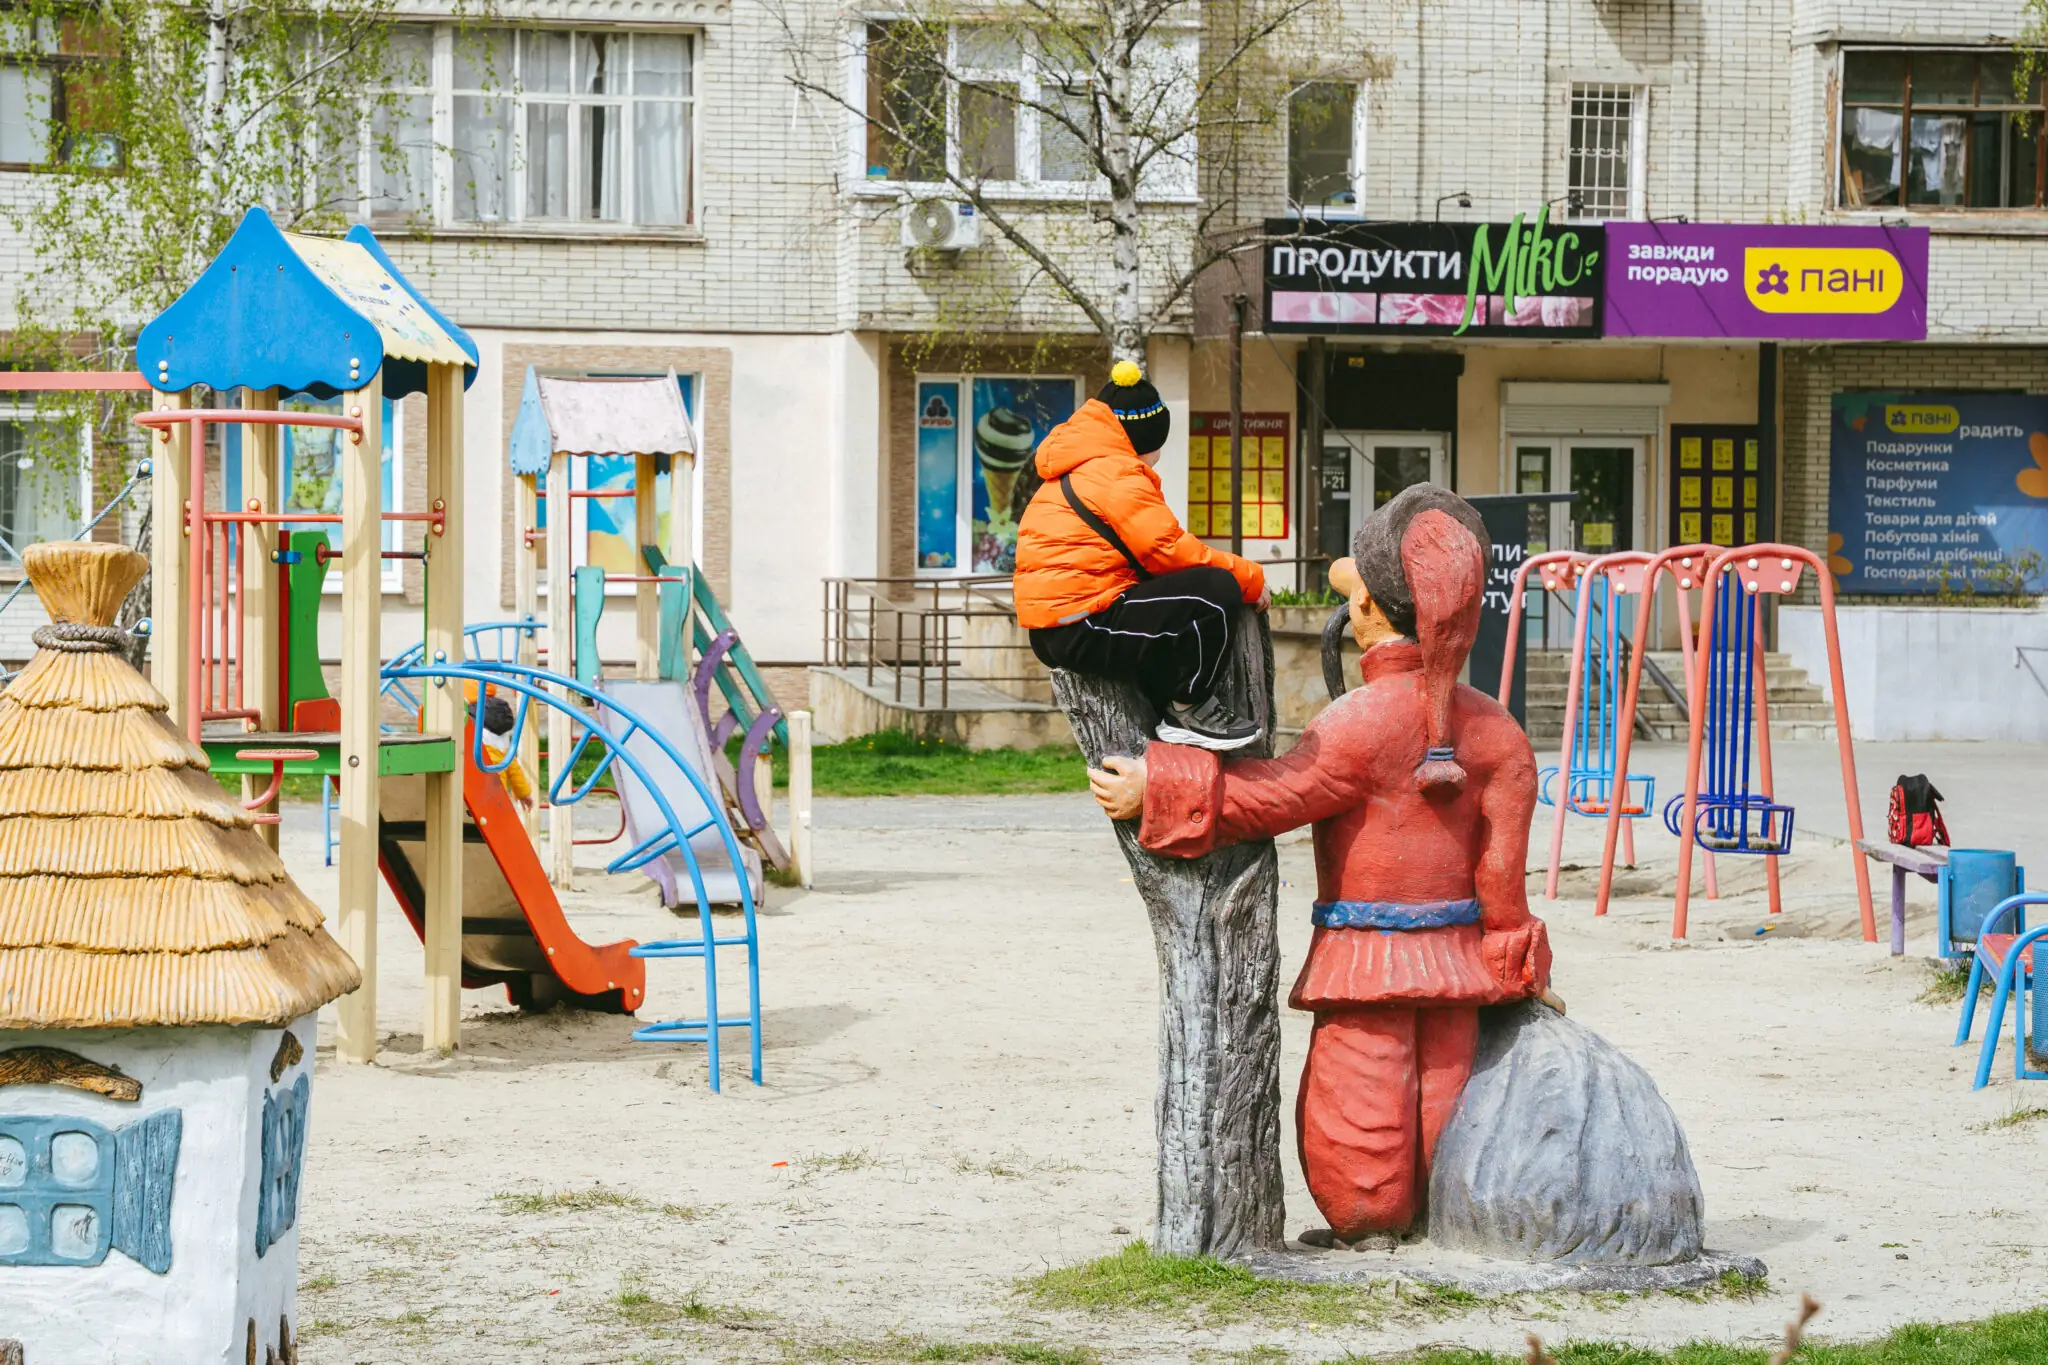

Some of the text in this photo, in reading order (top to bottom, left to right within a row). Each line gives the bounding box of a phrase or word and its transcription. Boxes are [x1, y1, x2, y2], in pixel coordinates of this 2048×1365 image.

[1628, 244, 1715, 261] завжди
[1272, 246, 1462, 285] ПРОДУКТИ
[1627, 264, 1729, 285] порадую
[1243, 419, 1284, 430] ТИЖНЯ
[1959, 424, 2024, 440] радить
[1866, 441, 1952, 456] Подарунки
[1866, 459, 1949, 472] Косметика
[1866, 476, 1938, 492] Парфуми
[1865, 494, 1936, 507] Текстиль
[1865, 512, 1997, 527] Товари для дітей
[1865, 530, 1979, 545] Побутова хімія
[1864, 548, 1930, 563] Потрібні
